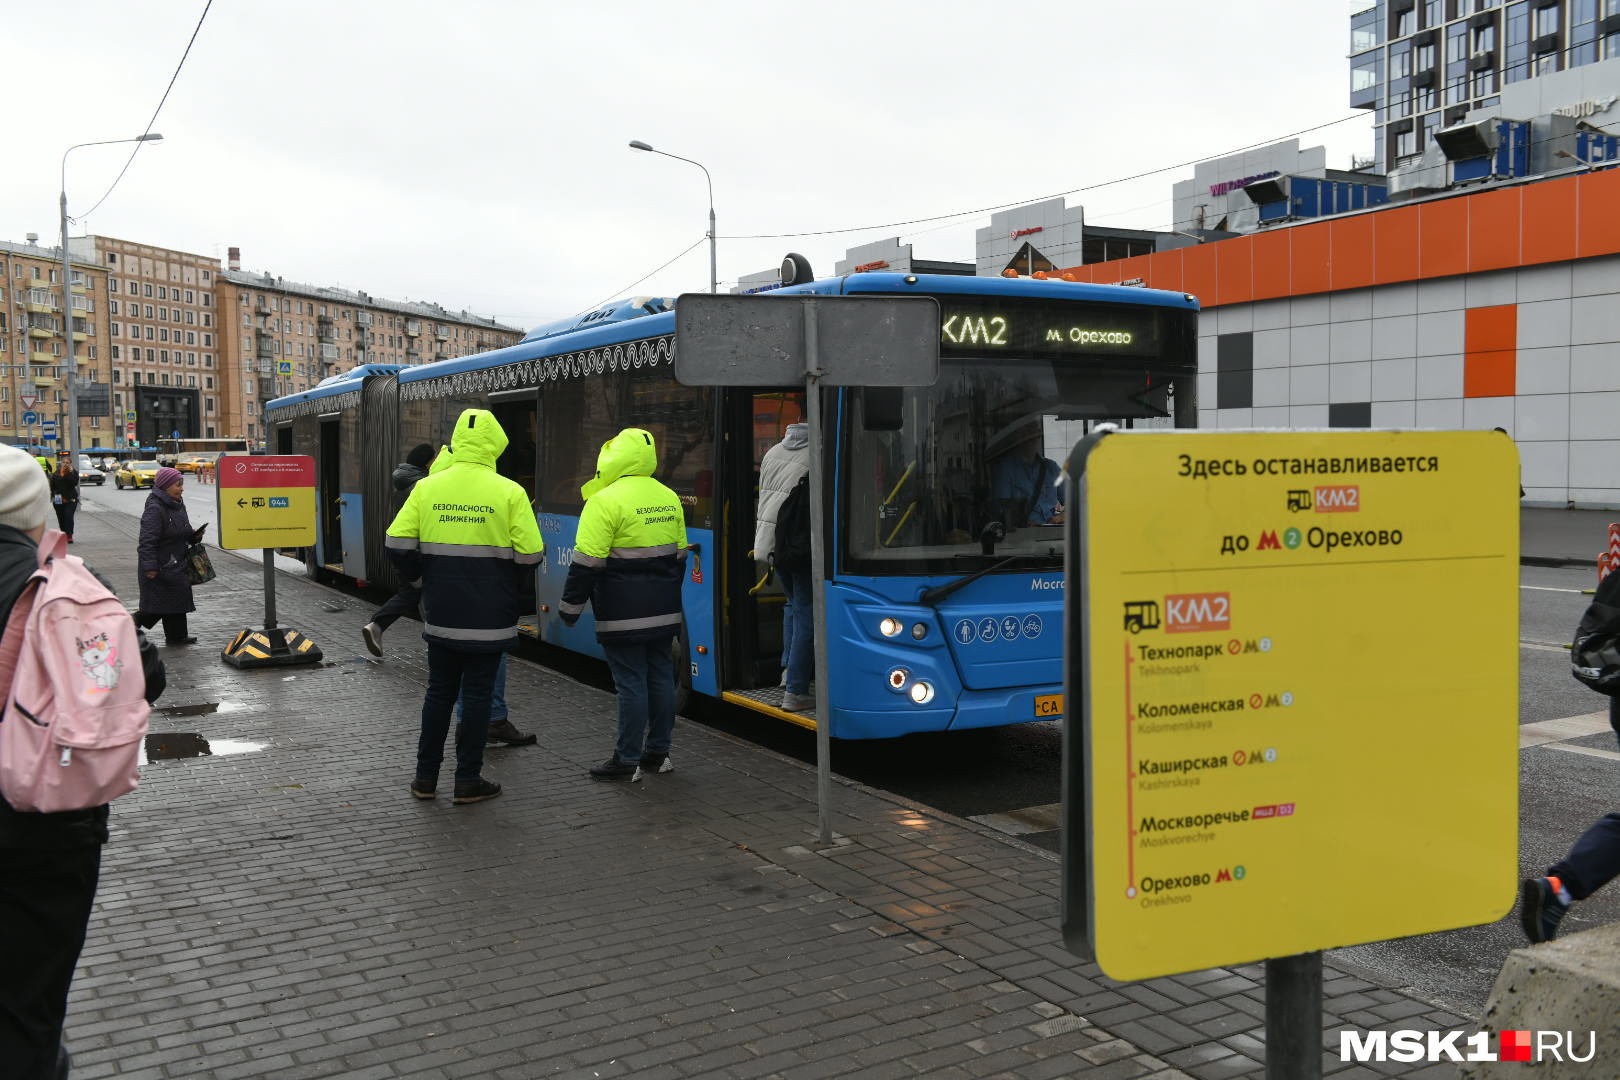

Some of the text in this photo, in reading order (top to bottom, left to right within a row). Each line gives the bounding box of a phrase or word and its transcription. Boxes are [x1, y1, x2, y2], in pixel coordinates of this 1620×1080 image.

[1069, 327, 1132, 345] Орехово
[1178, 454, 1439, 479] Здесь останавливается
[1315, 488, 1358, 507] КМ2
[432, 503, 495, 514] БЕЗОПАСНОСТЬ
[636, 505, 677, 515] БЕЗОПАСНОСТЬ
[439, 514, 487, 524] ДВИЖЕНИЯ
[644, 515, 676, 525] ДВИЖЕНИЯ
[1220, 535, 1249, 555] до
[1307, 526, 1403, 552] Орехово
[1167, 597, 1229, 625] КМ2
[1138, 644, 1223, 661] Технопарк
[1138, 663, 1200, 677] Tekhnopark
[1138, 698, 1245, 718] Коломенская
[1137, 720, 1213, 734] Kolomenskaya
[1139, 756, 1228, 775] Каширская
[1138, 776, 1200, 791] Kashirskaya
[1140, 810, 1250, 833] Москворечье
[1140, 832, 1216, 849] Moskvorechye
[1140, 872, 1211, 895] Орехово
[1140, 894, 1192, 909] Orekhovo
